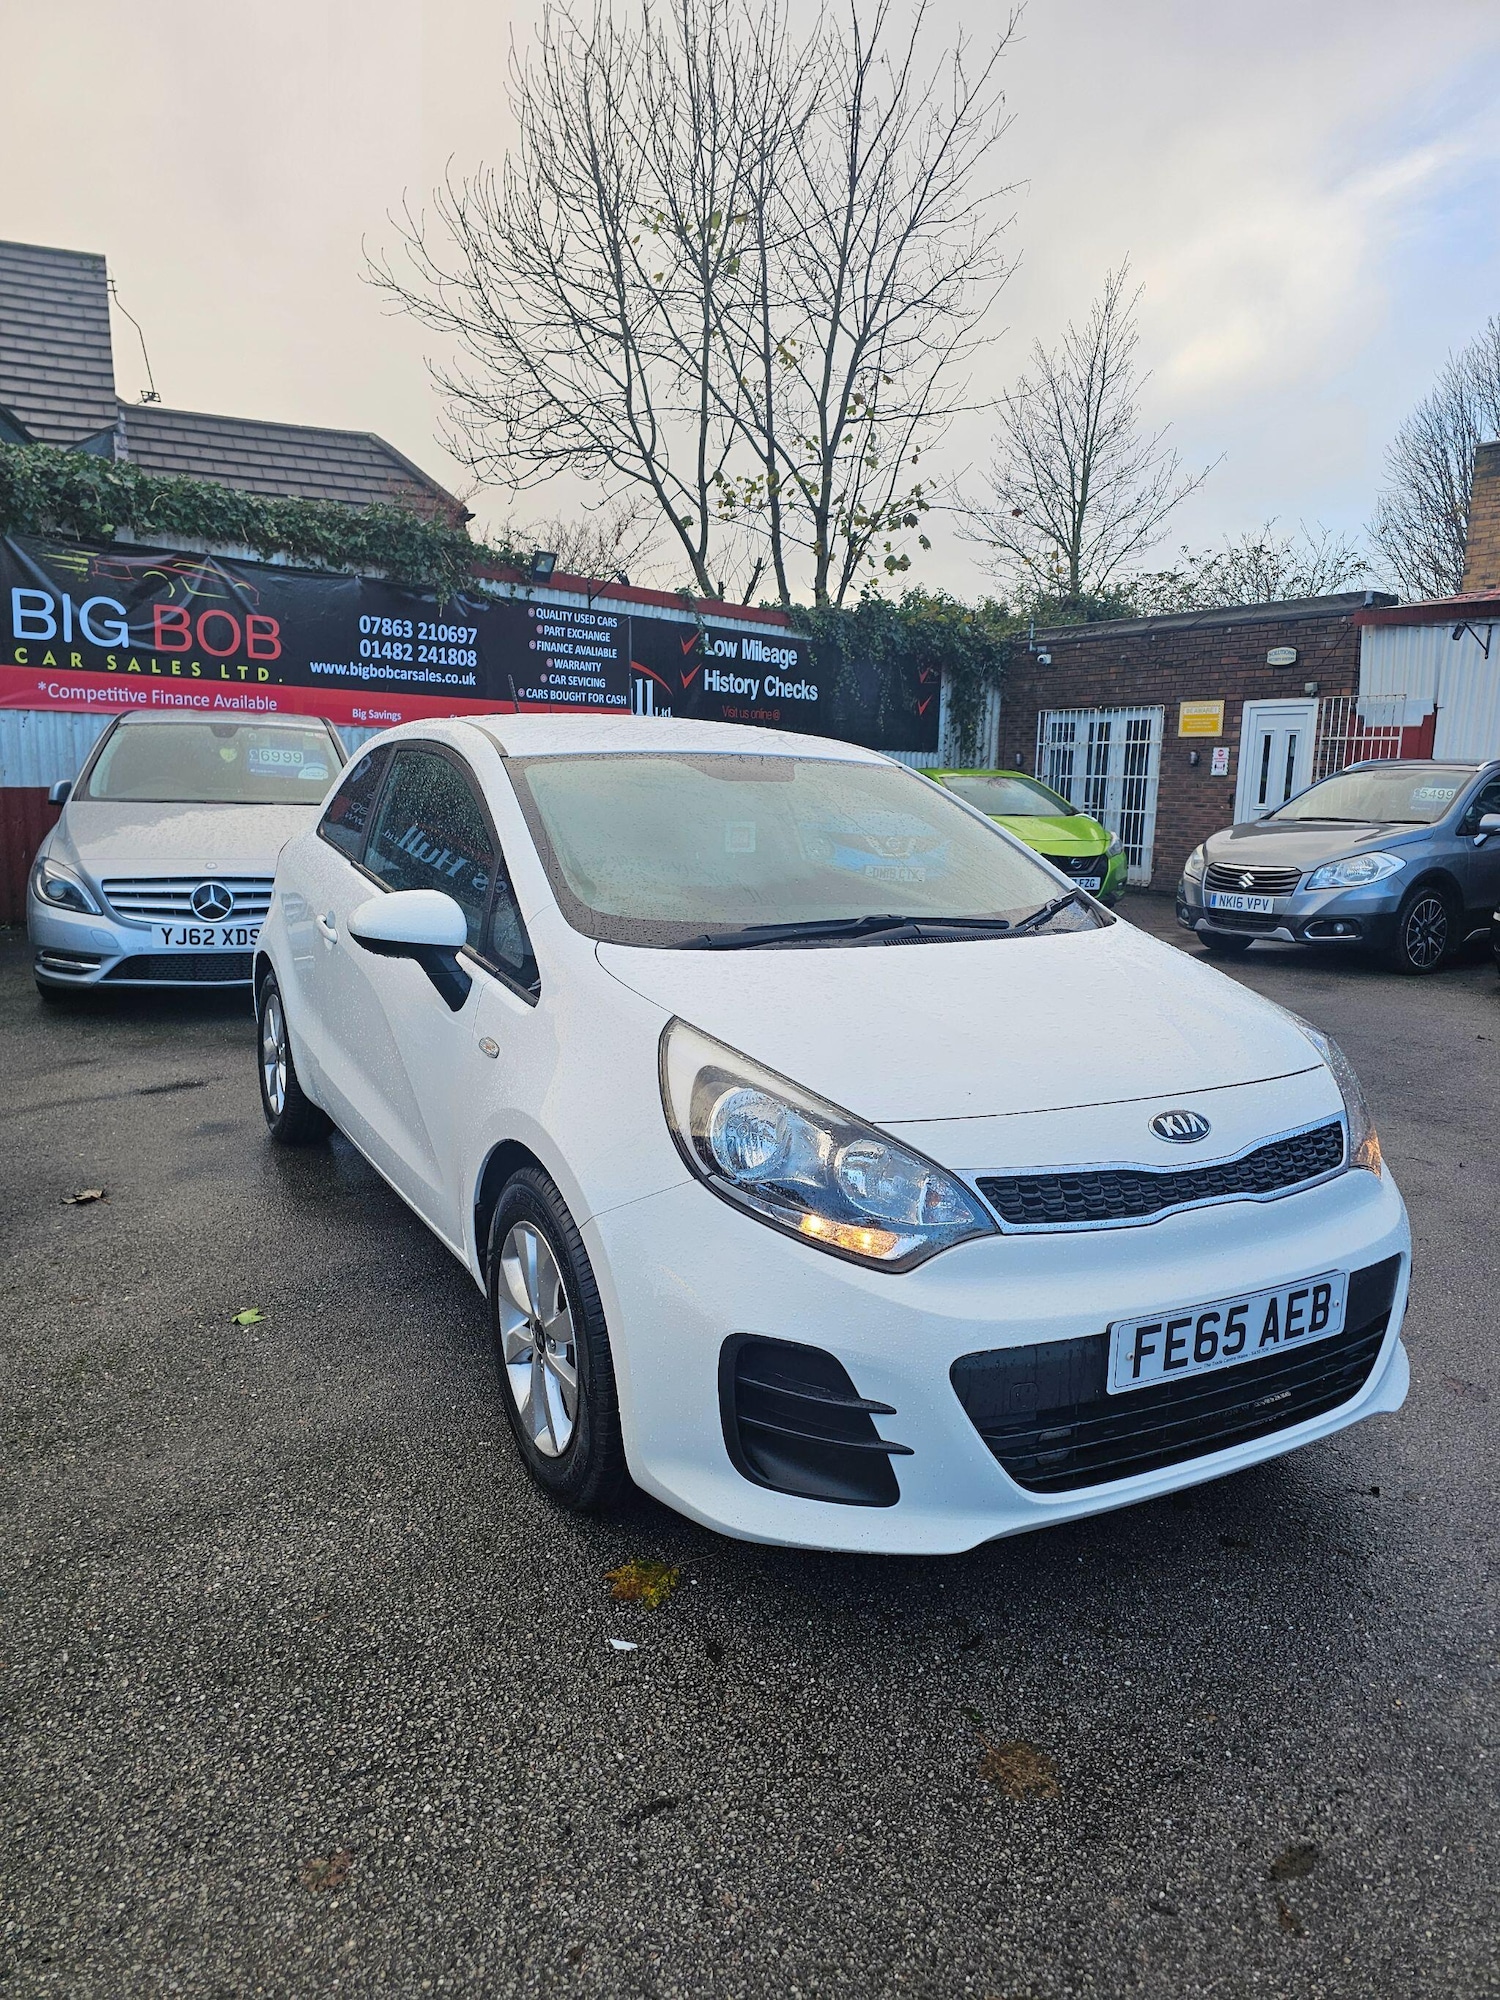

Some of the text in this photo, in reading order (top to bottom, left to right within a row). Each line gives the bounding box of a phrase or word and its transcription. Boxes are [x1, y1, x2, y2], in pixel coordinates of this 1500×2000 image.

[11, 587, 282, 660] BIG BOB
[536, 608, 618, 628] QUALITY USED CARS
[359, 615, 478, 645] 07863 210697
[544, 626, 610, 642] PART EXCHANGE
[360, 639, 478, 668] 01482 241808
[536, 641, 618, 658] FINANCE AVALIABLE
[704, 633, 798, 670] Low Mileage
[14, 647, 283, 683] CAR SALES LTD.
[310, 660, 476, 686] www.bigbobcarsales.co.uk
[554, 658, 602, 672] WARRANTY
[548, 674, 606, 688] CAR SEVICING
[704, 669, 818, 701] History Checks
[152, 690, 210, 707] Finance
[214, 694, 278, 711] Available
[526, 688, 626, 706] CARS BOUGHT FOR CASH
[352, 708, 402, 722] Big Savings
[722, 705, 738, 718] Visit
[740, 710, 748, 718] us
[1219, 894, 1269, 910] NK16 VPV
[162, 928, 260, 946] YJ62 XDS
[1157, 1112, 1206, 1137] KIA
[1132, 1283, 1332, 1378] FE65 AEB
